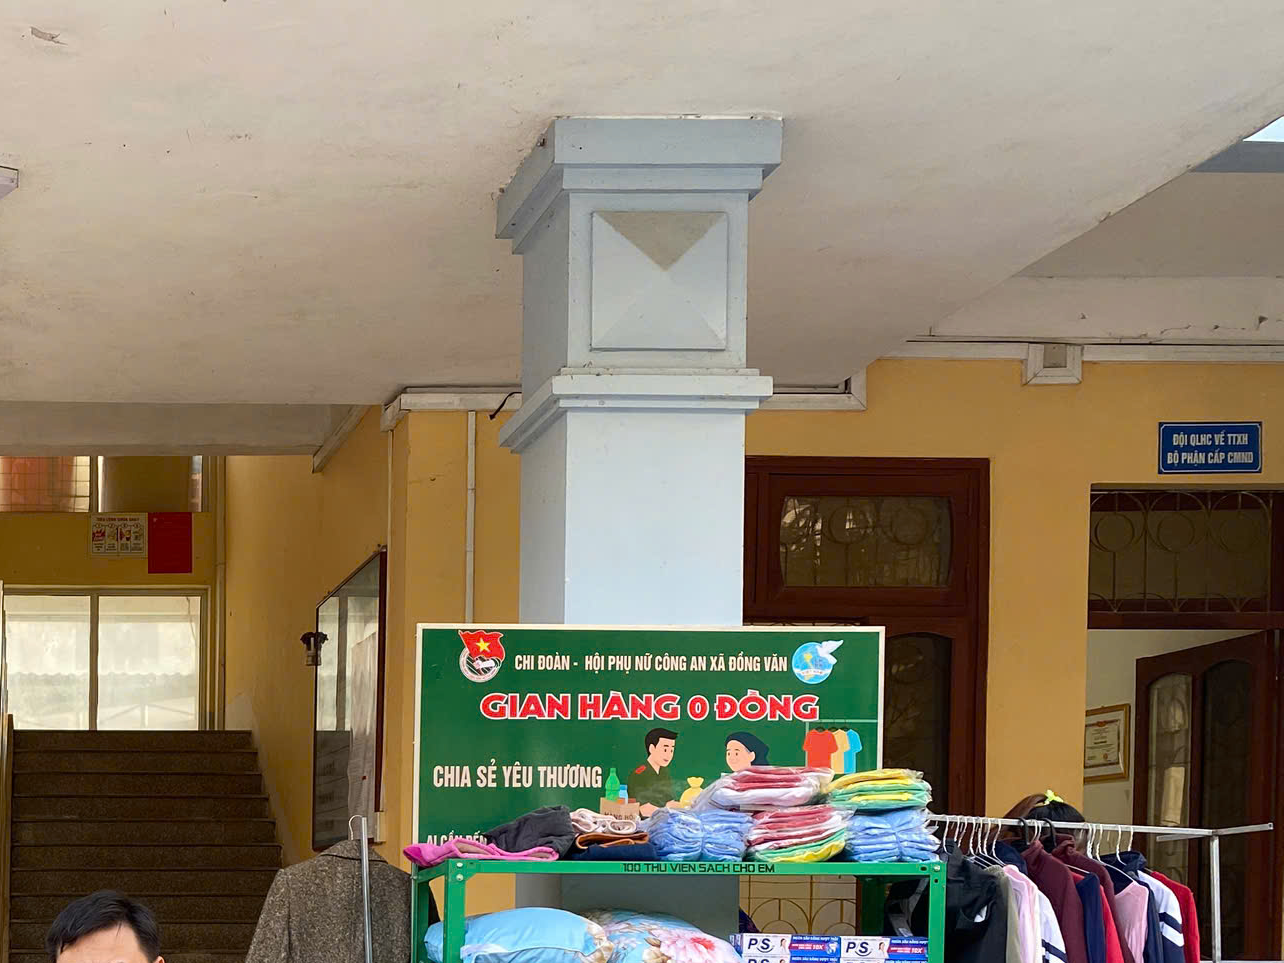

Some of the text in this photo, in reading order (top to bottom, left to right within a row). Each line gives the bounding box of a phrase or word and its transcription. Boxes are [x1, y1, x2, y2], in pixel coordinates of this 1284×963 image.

[1189, 433, 1213, 447] QLHC
[1227, 433, 1248, 445] TTXH
[1167, 450, 1179, 467] BỘ
[1181, 450, 1205, 467] PHẬN
[1207, 448, 1226, 464] CẤP
[515, 654, 535, 671] CHI
[537, 651, 570, 671] ĐOÀN
[584, 652, 605, 674] HỘI
[608, 655, 630, 674] PHỤ
[635, 652, 653, 671] NỮ
[654, 652, 687, 672] CÔNG
[690, 655, 706, 672] AN
[709, 653, 726, 672] XÃ
[764, 653, 788, 672] VĂN
[479, 689, 820, 721] GIAN HÀNG 0 ĐỒNG
[432, 758, 603, 788] CHIA SẺ YÊU THƯƠNG
[698, 863, 730, 873] SACH
[732, 863, 755, 873] CHO
[758, 863, 775, 873] EM
